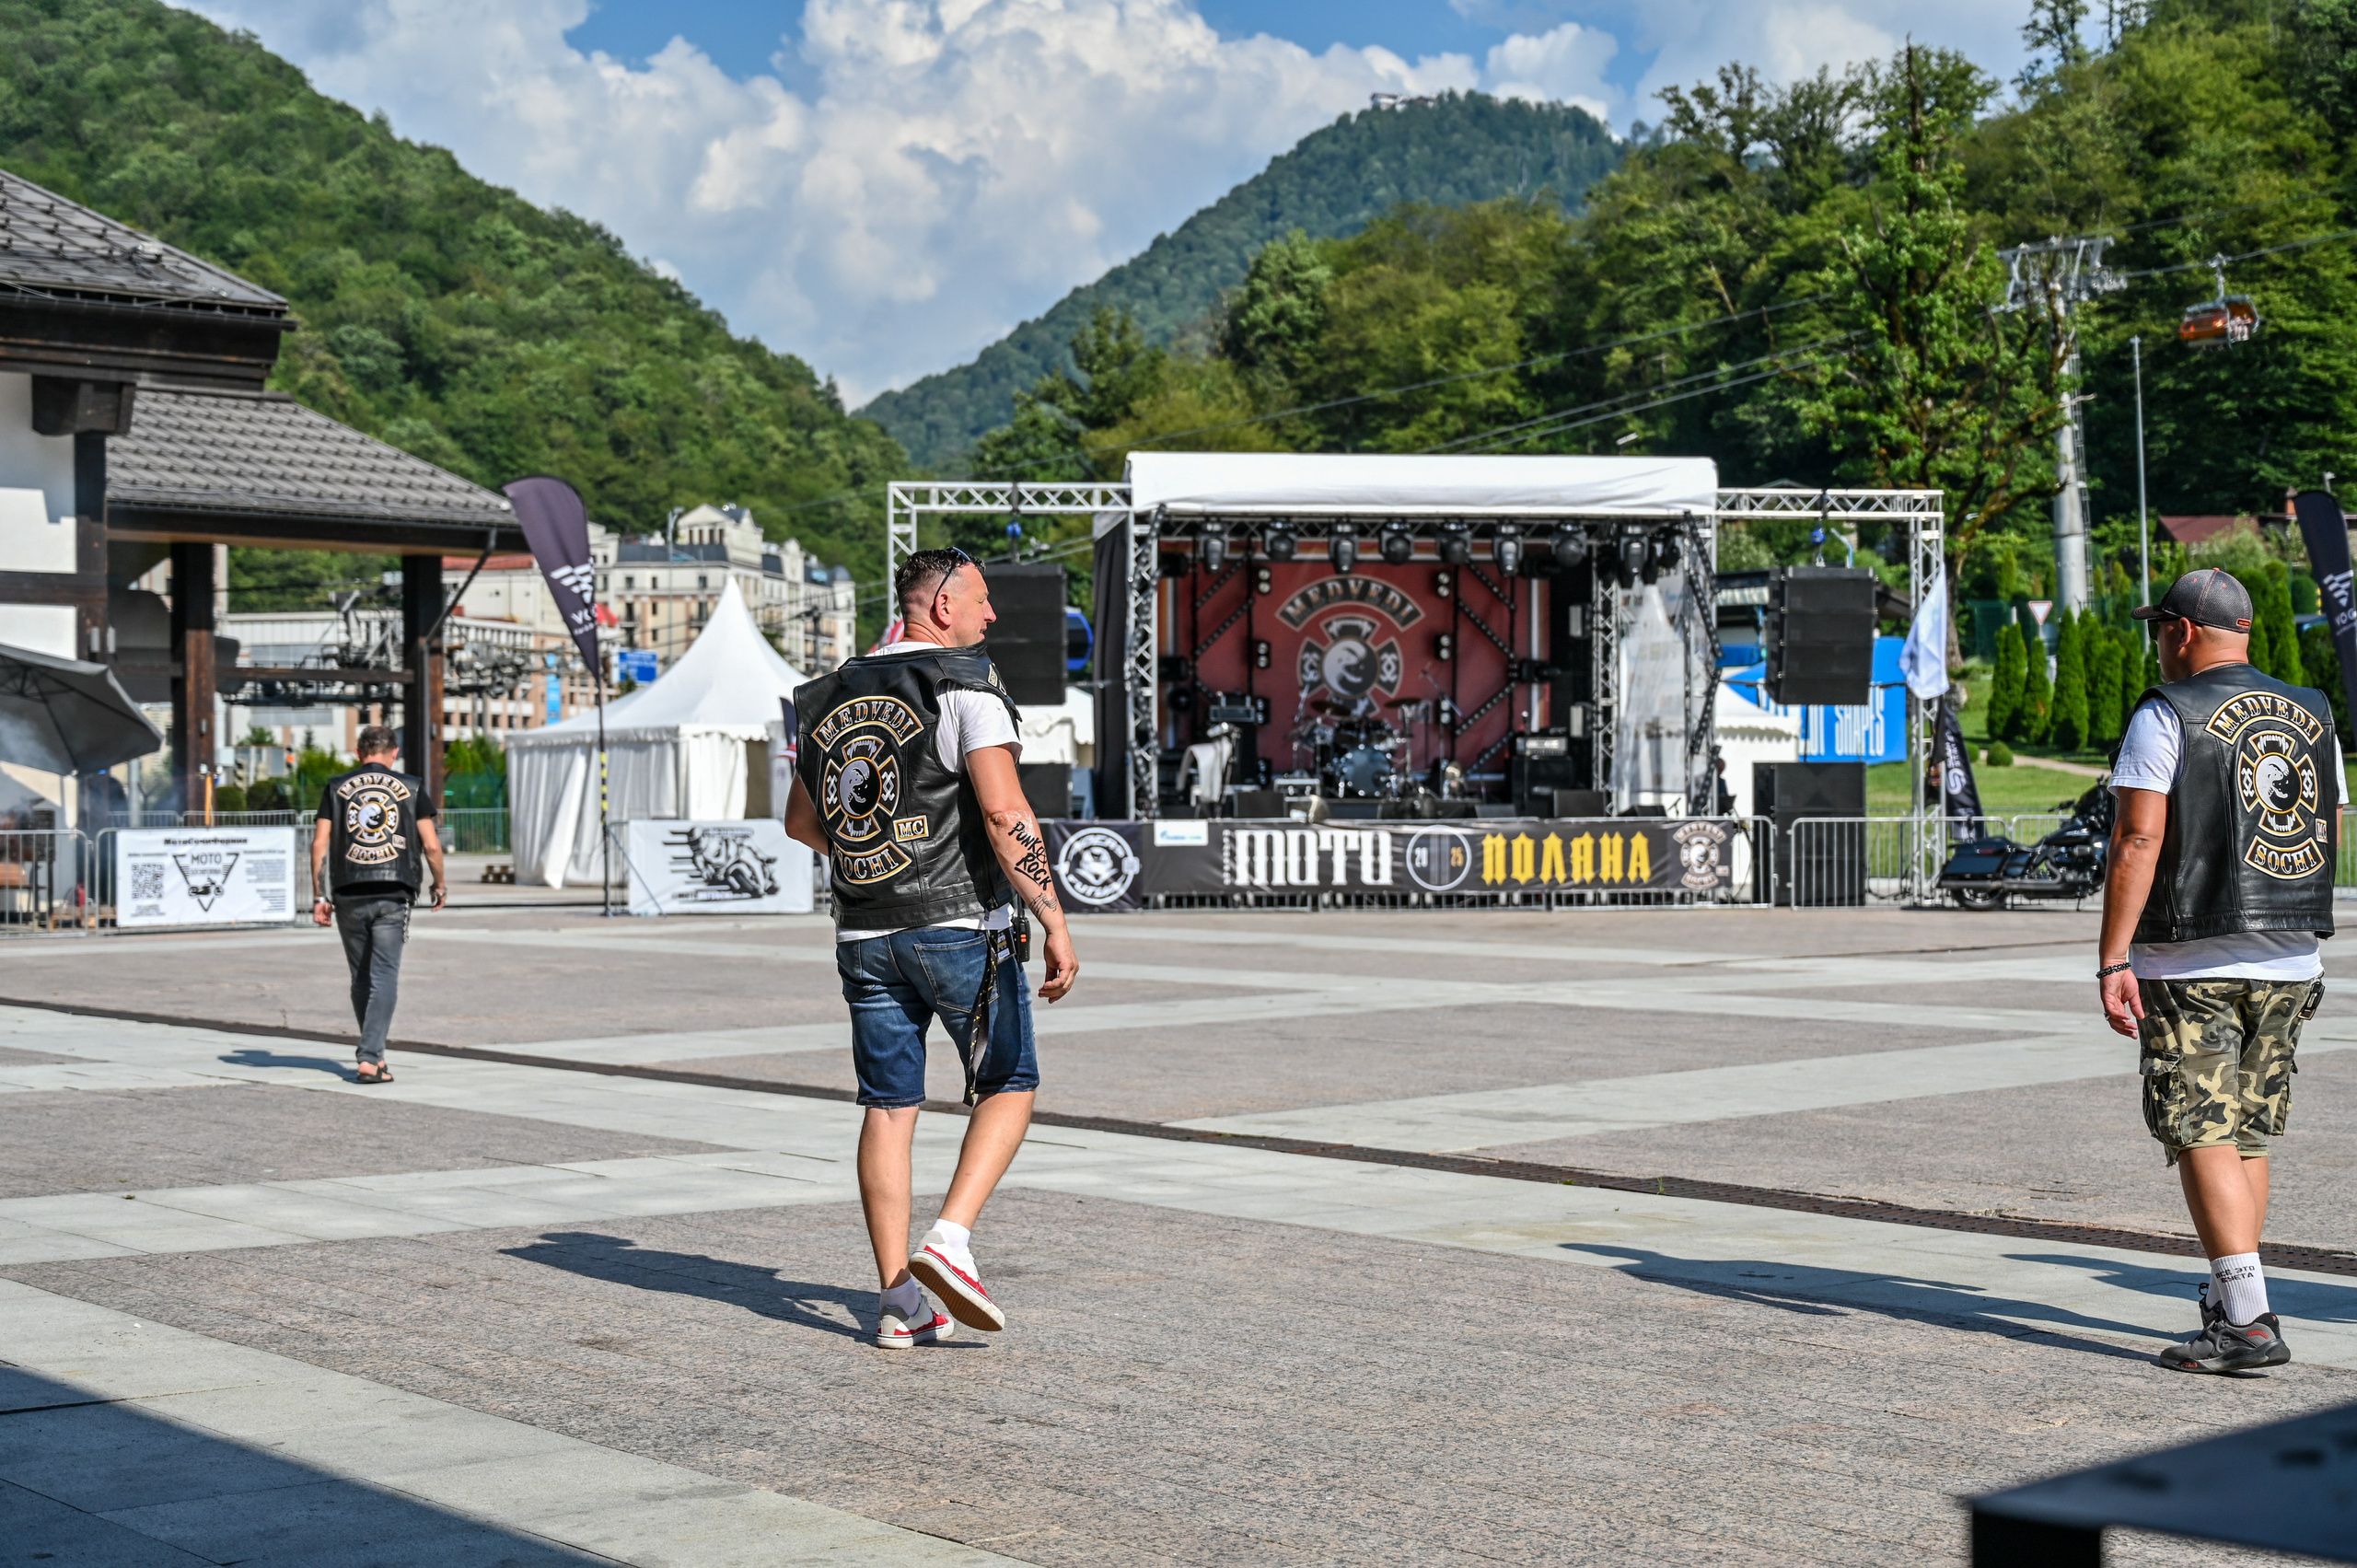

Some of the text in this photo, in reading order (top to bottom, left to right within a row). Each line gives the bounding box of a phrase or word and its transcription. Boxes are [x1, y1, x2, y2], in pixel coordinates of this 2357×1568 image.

[1285, 578, 1413, 623] MEDVEDI
[819, 701, 914, 744] MEDVEDI
[2214, 696, 2316, 738] MEDVEDI
[341, 775, 406, 797] MEDVEDI
[898, 819, 923, 838] MC
[1007, 821, 1041, 854] PUNK
[352, 847, 391, 861] SOCHI
[1481, 831, 1651, 886] ПОЛЯНА
[2255, 844, 2317, 874] SOCHI
[1016, 852, 1051, 890] ROCK
[2235, 1265, 2256, 1273] ЭТО
